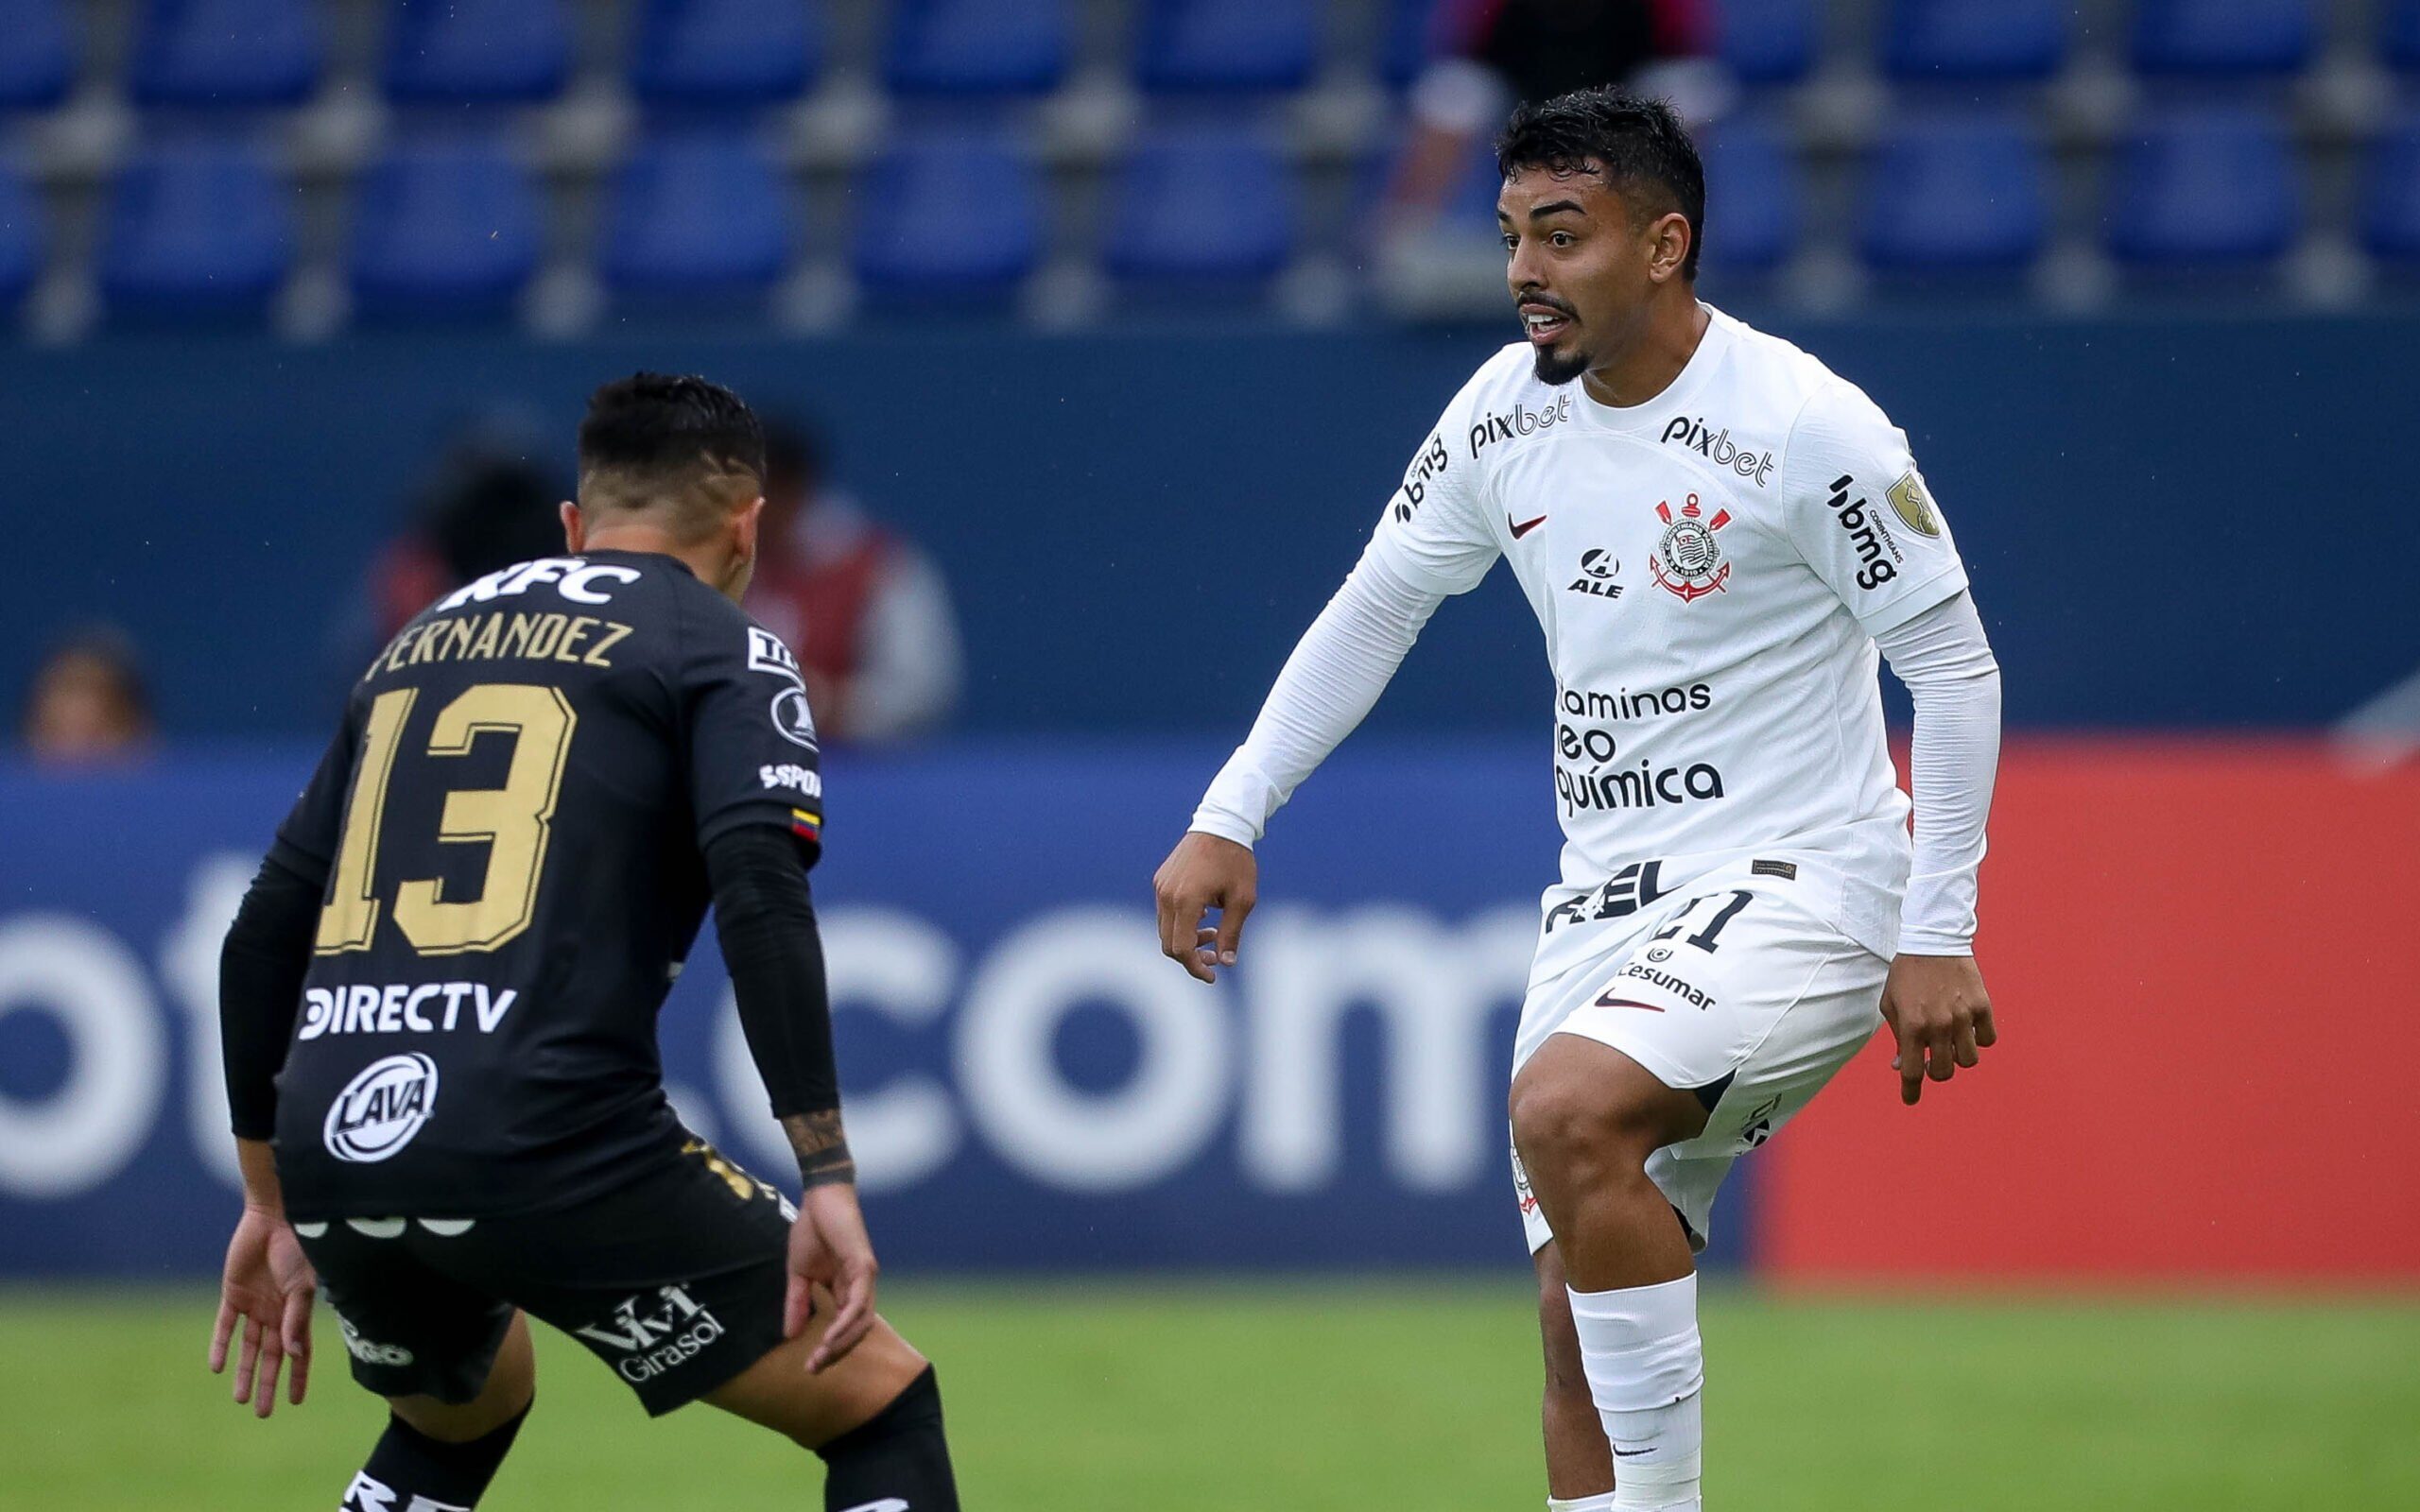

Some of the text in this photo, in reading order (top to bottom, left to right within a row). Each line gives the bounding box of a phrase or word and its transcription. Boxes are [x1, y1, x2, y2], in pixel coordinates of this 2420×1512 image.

[1469, 394, 1571, 459] pixbet
[1660, 416, 1774, 489] pixbet
[1838, 498, 1897, 590] bmg
[1869, 509, 1904, 564] CORINTHIANS
[1567, 577, 1624, 599] ALE
[1556, 759, 1724, 818] química
[314, 684, 578, 957] 13
[298, 982, 518, 1040] DIRECTV
[335, 1078, 428, 1134] LAVA
[619, 1310, 726, 1382] Girasol
